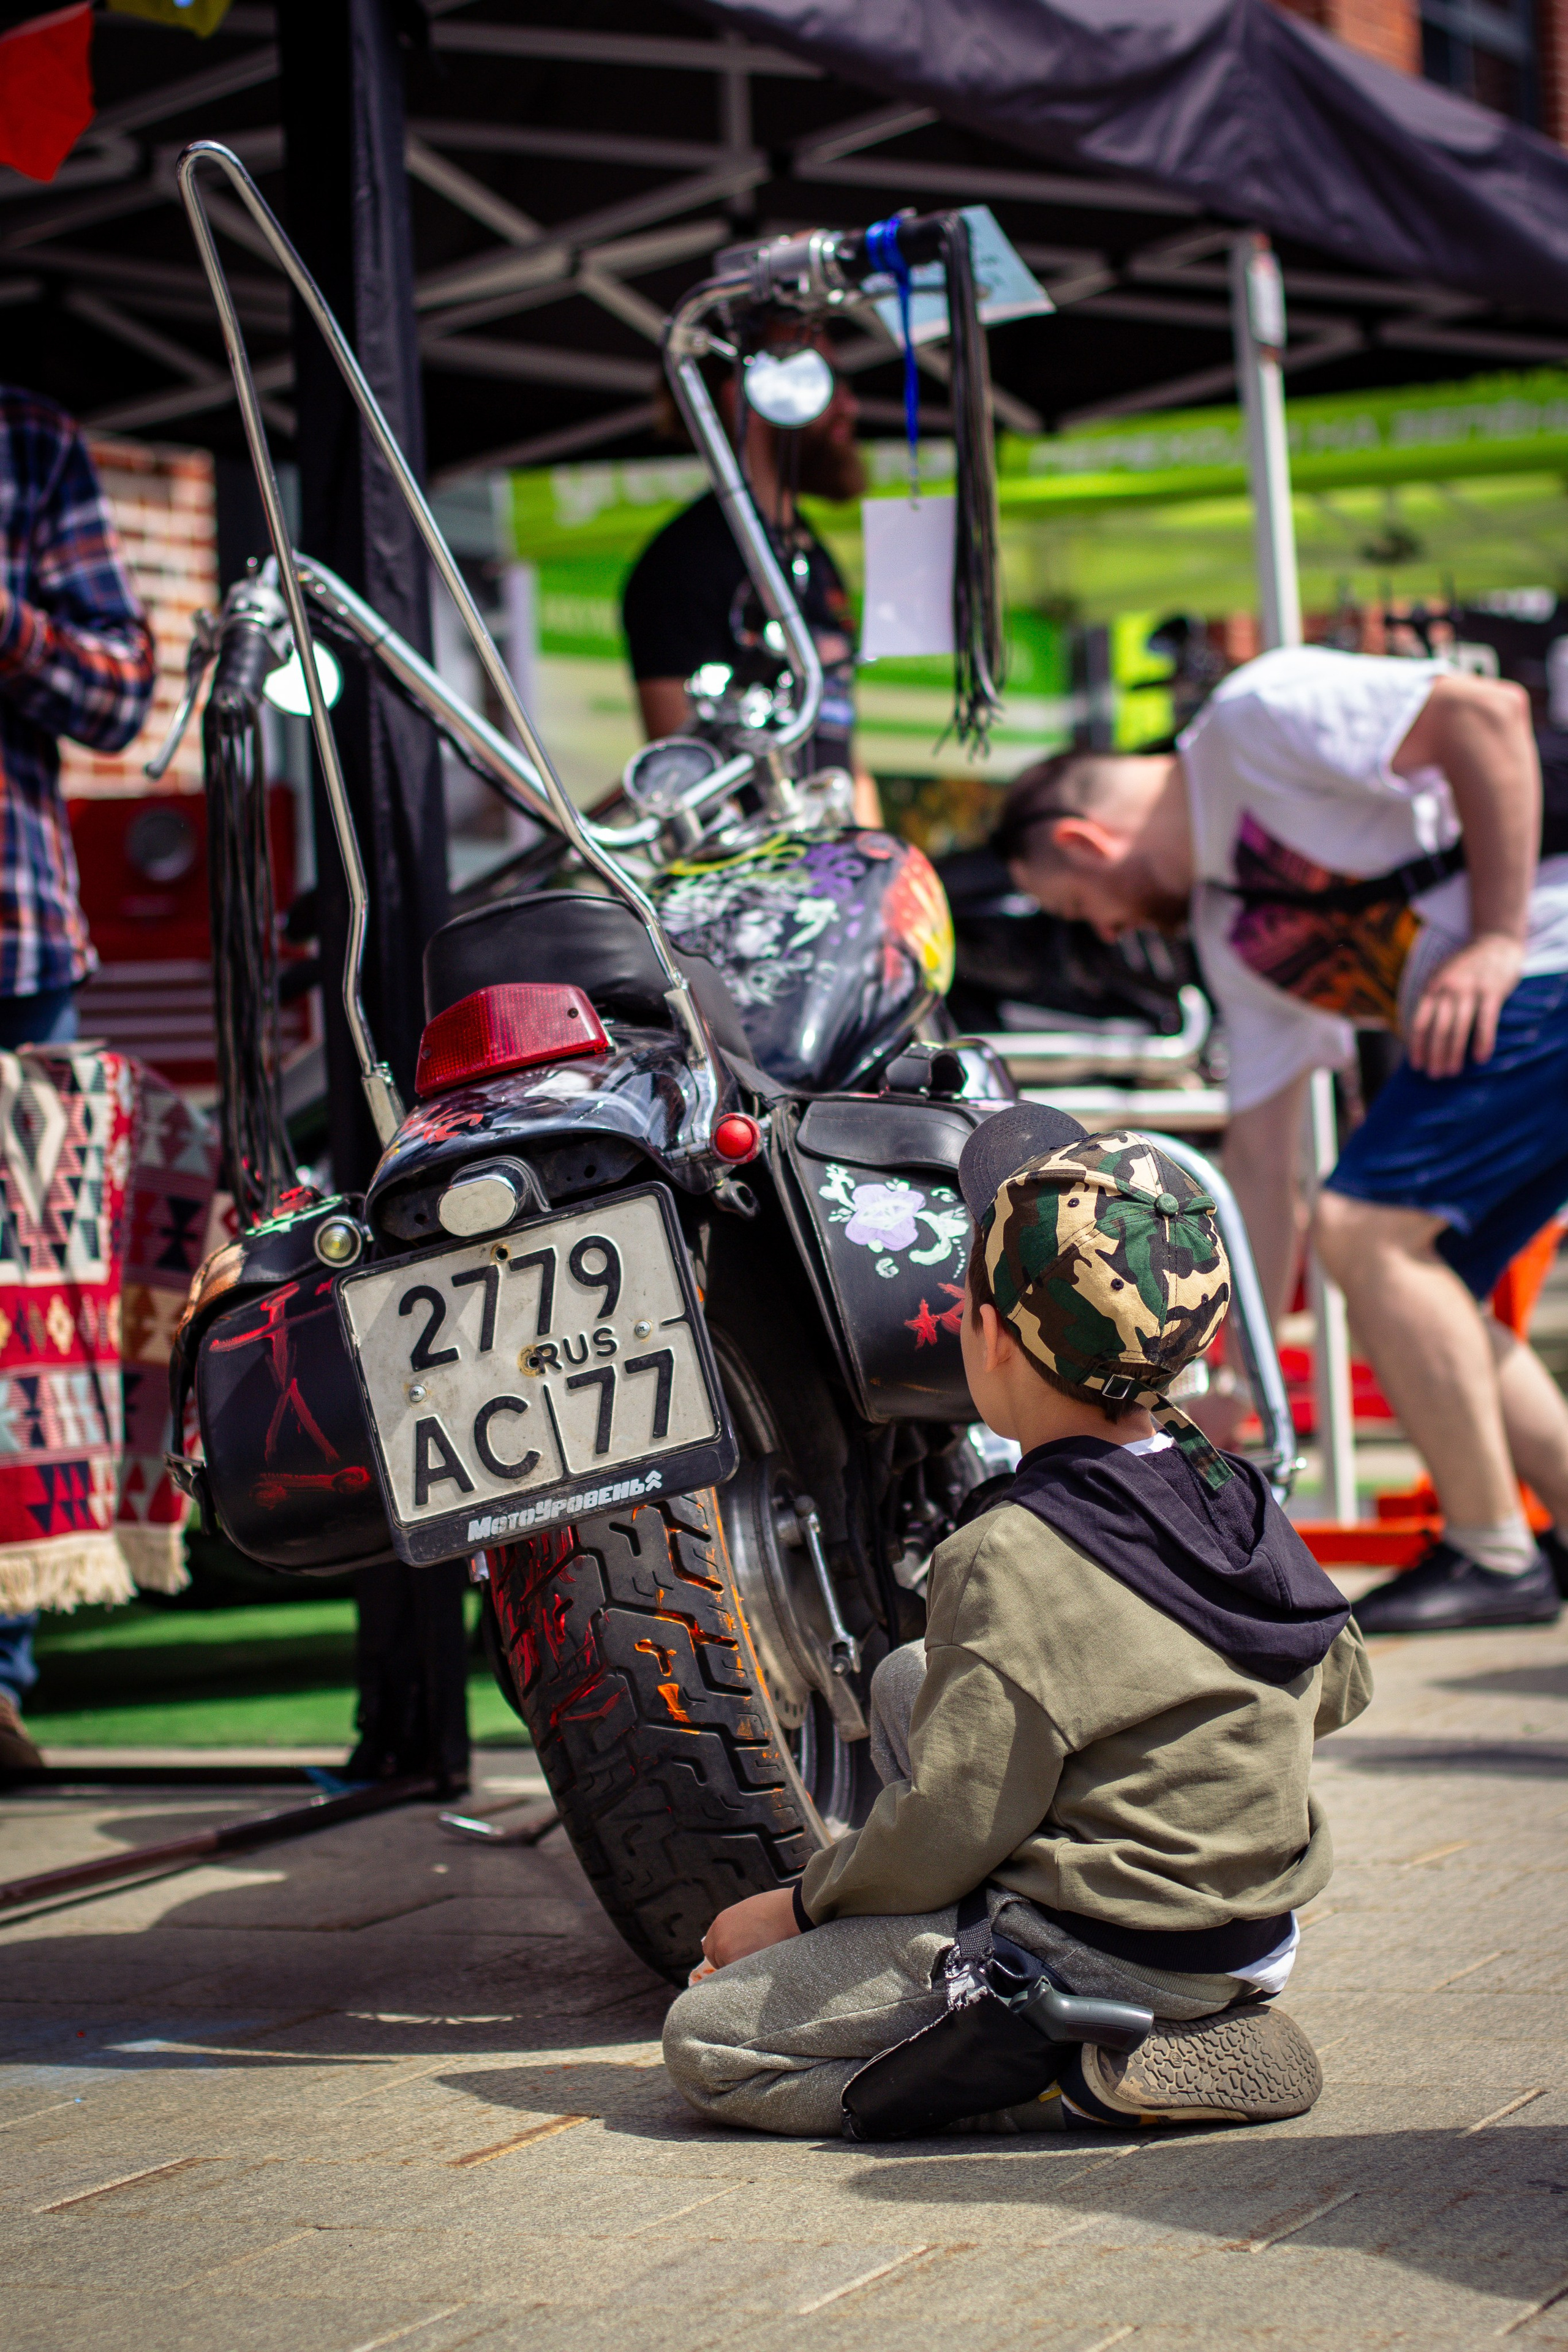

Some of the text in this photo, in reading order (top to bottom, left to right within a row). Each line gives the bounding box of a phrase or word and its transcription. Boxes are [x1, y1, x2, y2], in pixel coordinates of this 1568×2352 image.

[398, 1235, 622, 1373] 2779
[534, 1327, 619, 1375] RUS
[566, 1348, 674, 1455] 77
